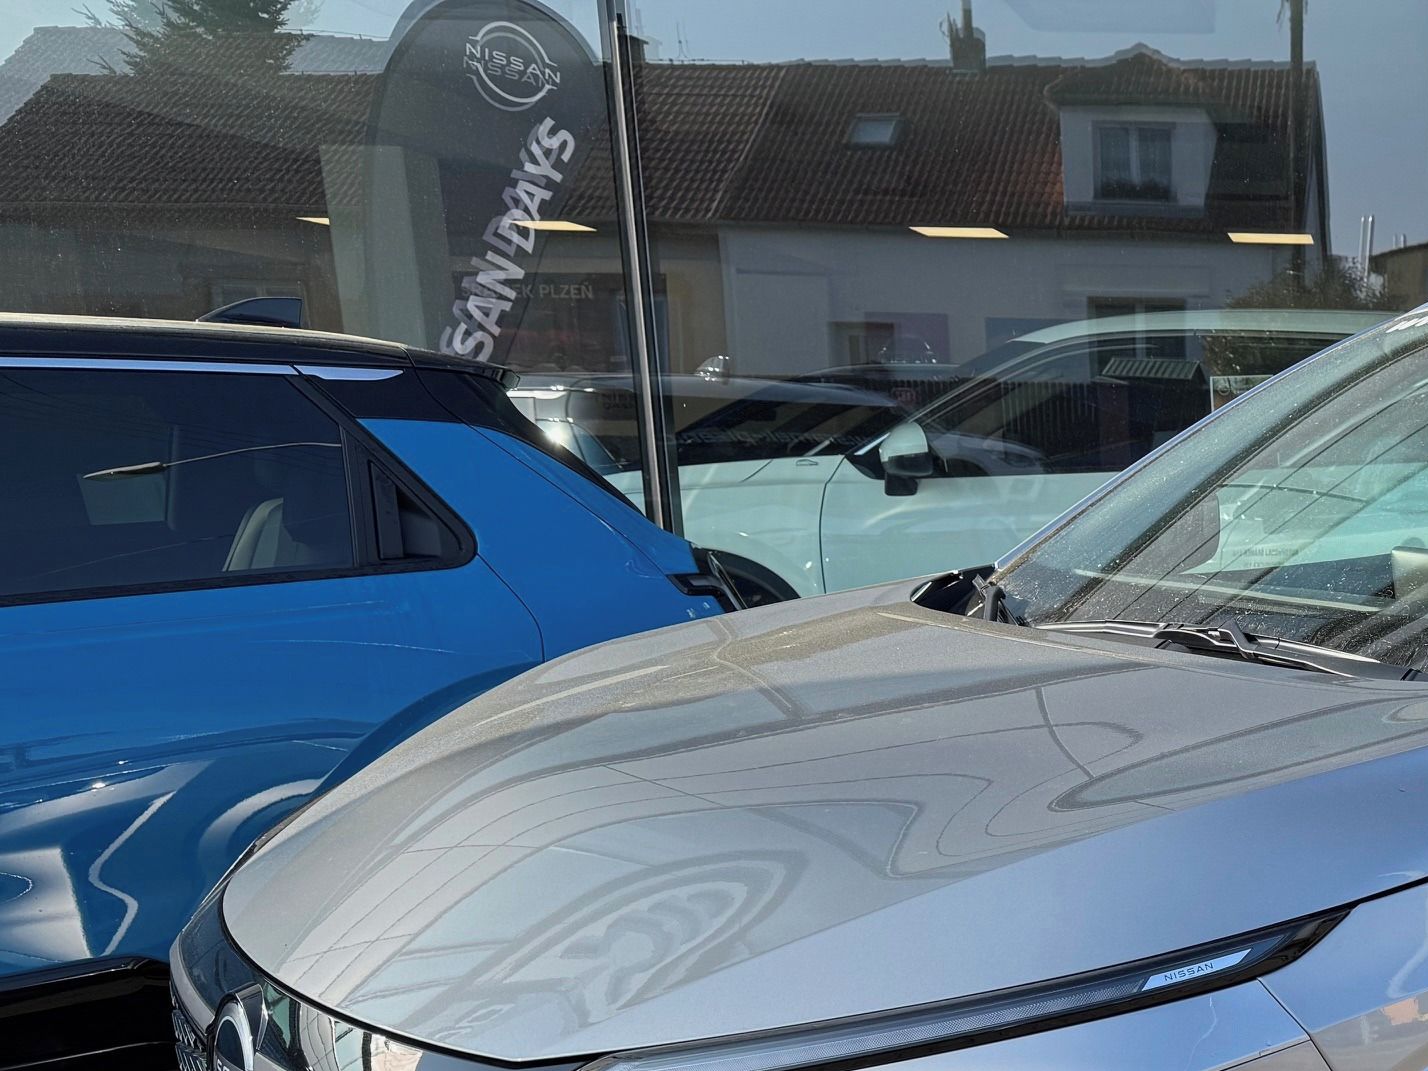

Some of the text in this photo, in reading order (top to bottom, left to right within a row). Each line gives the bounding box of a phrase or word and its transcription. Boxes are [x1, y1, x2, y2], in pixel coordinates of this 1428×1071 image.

[465, 42, 561, 84] NISSAN
[497, 116, 576, 255] DAYS
[1164, 962, 1214, 982] NISSAN
